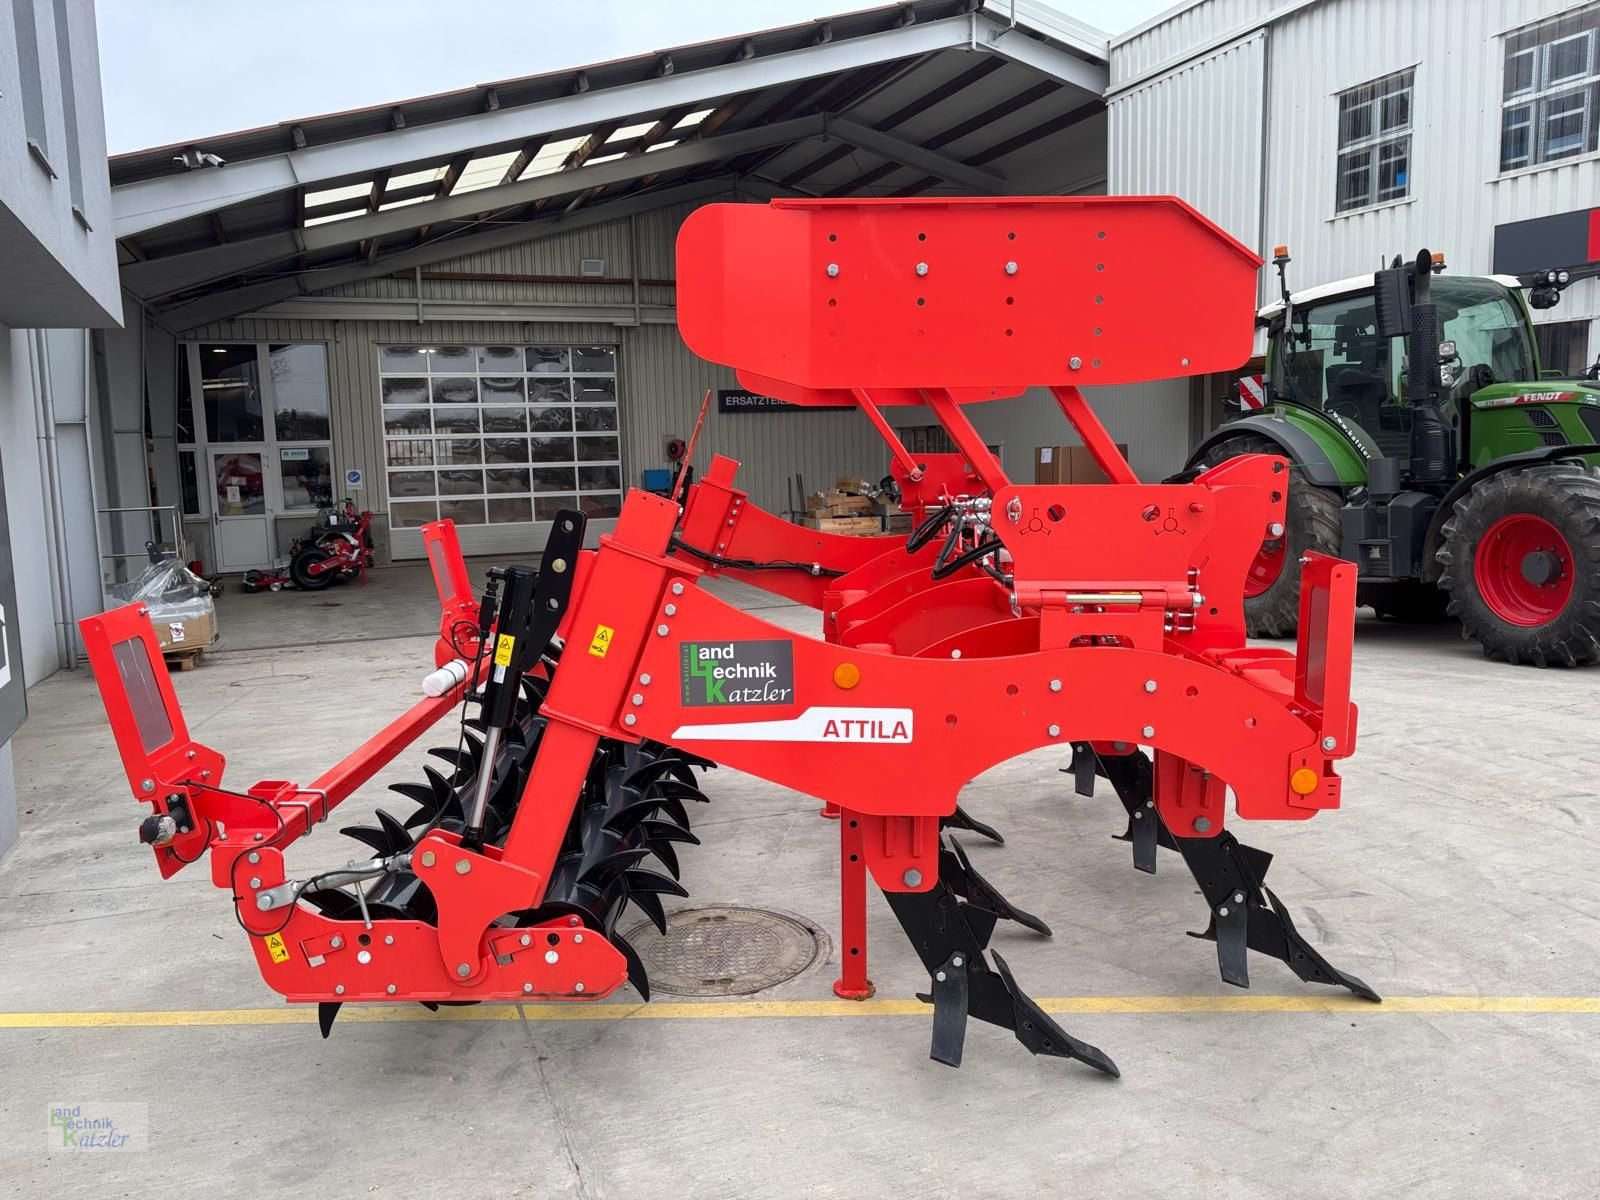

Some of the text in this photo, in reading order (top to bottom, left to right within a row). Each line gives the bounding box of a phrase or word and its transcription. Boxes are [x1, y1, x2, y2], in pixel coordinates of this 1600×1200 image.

[725, 396, 793, 406] ERSATZTEIL
[1523, 391, 1564, 402] FENDT
[690, 643, 735, 677] Land
[699, 660, 777, 680] Technik
[706, 679, 792, 704] Katzler
[823, 719, 909, 739] ATTILA
